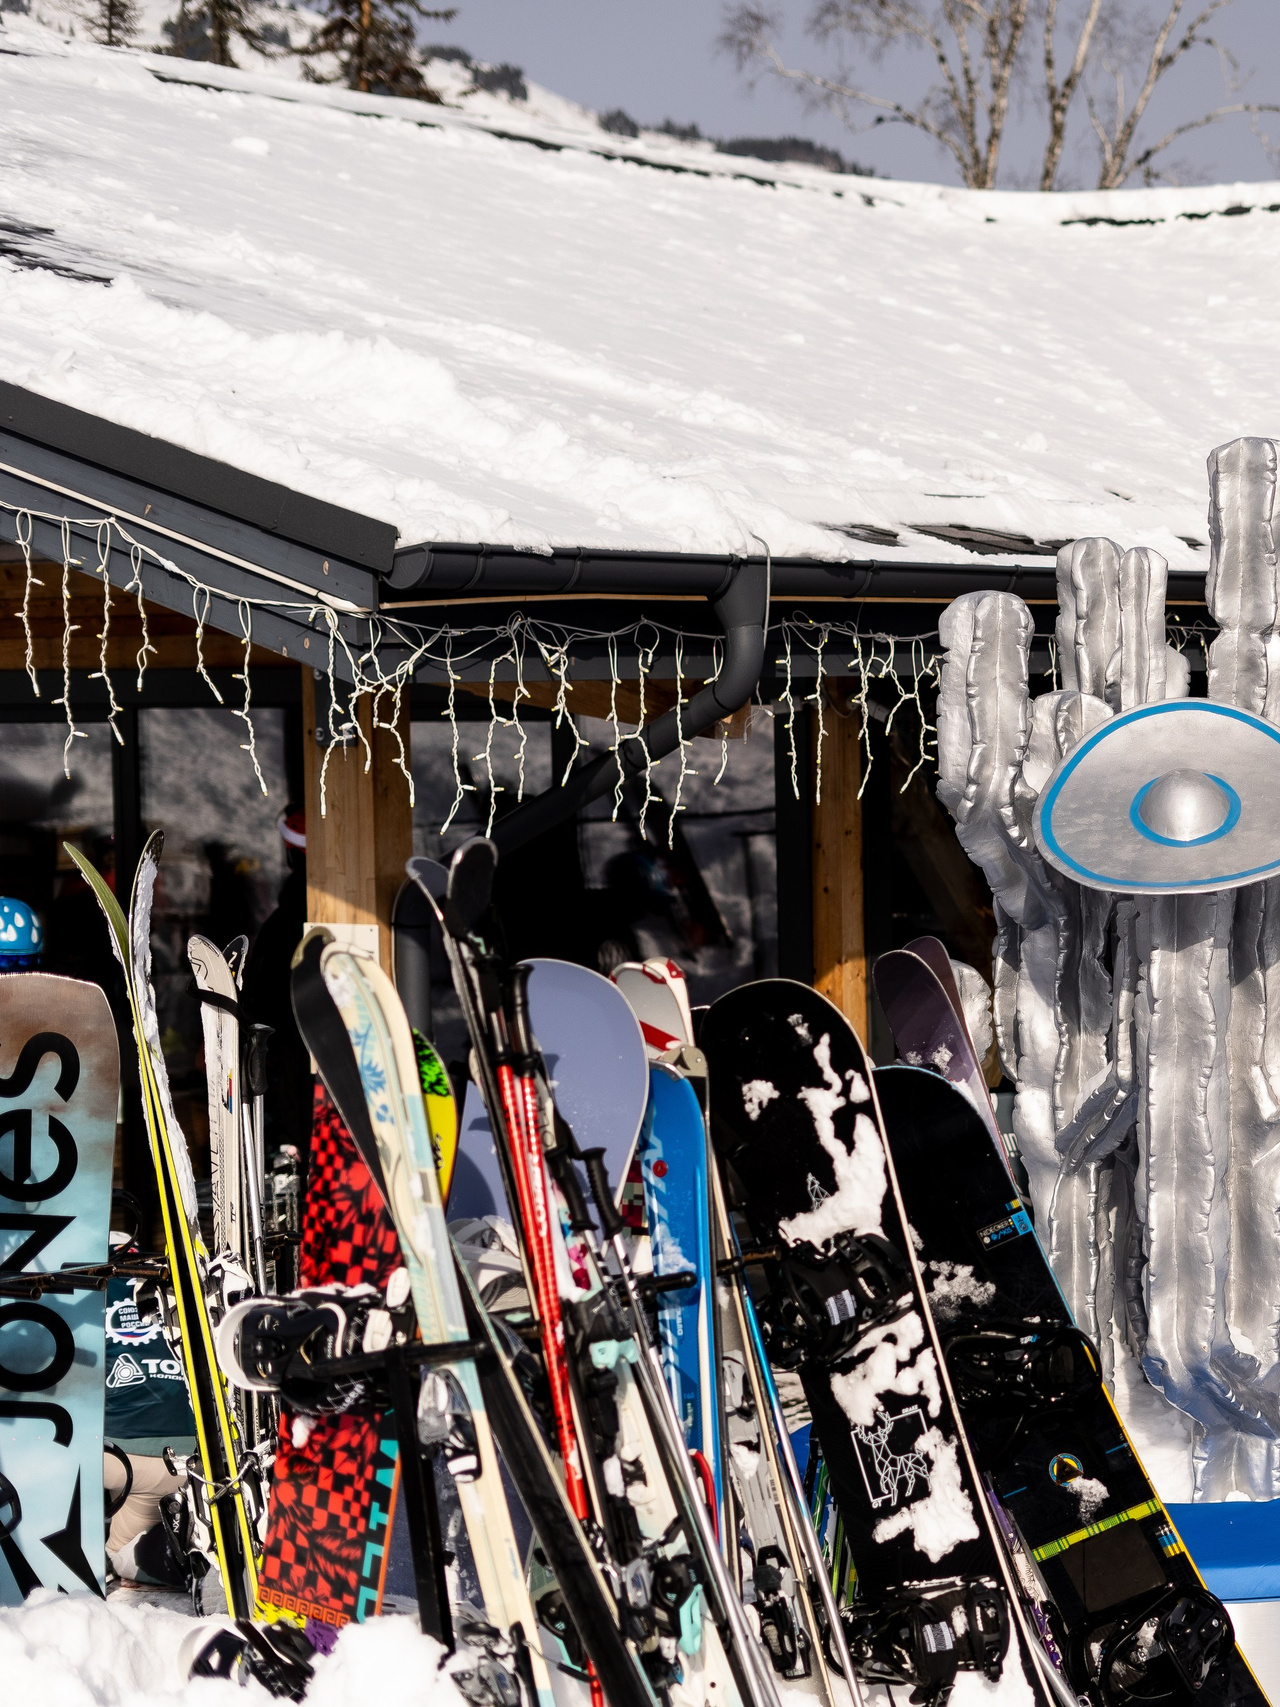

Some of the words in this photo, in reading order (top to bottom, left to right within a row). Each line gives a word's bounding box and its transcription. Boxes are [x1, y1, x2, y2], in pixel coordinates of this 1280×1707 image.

[121, 1320, 151, 1329] РОСС
[141, 1359, 184, 1375] ТО
[872, 1499, 883, 1509] GT
